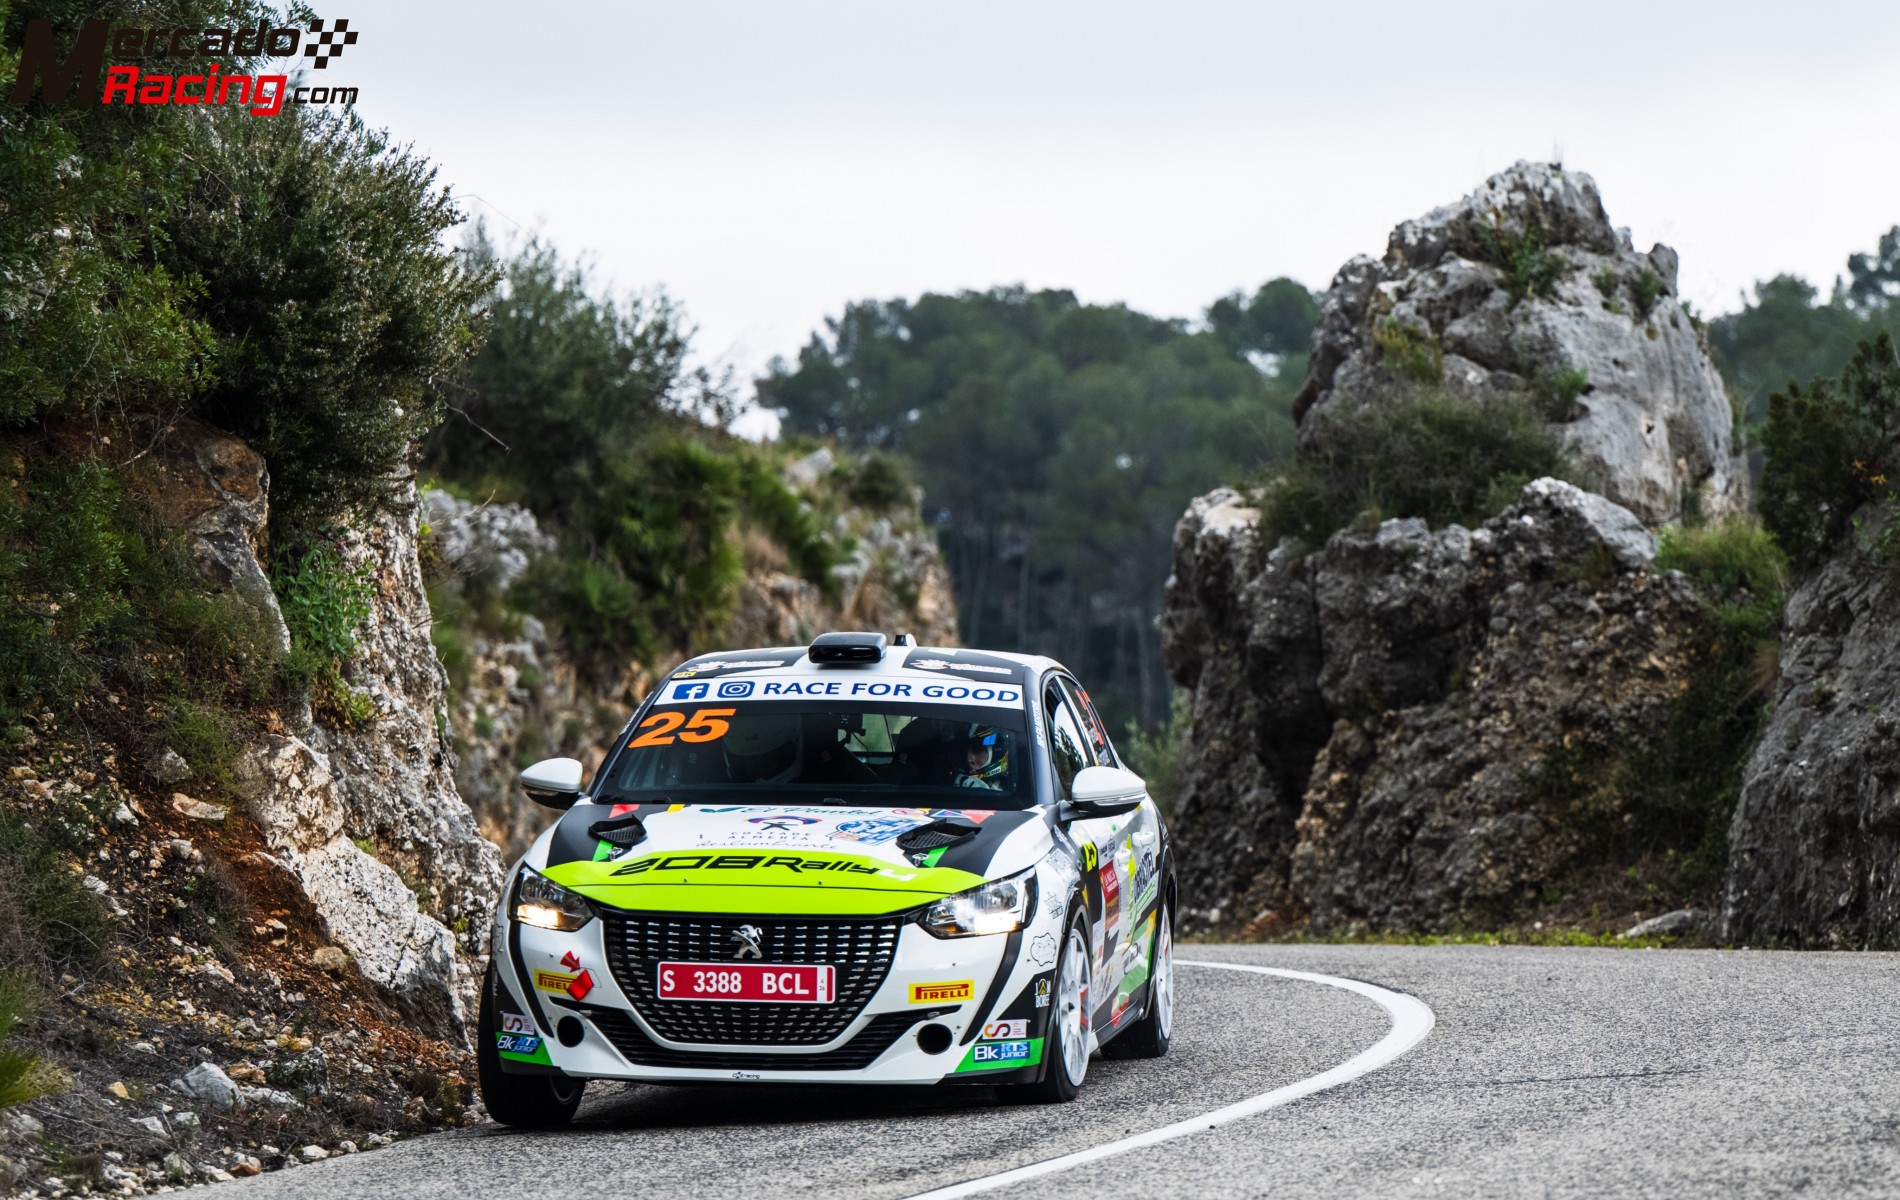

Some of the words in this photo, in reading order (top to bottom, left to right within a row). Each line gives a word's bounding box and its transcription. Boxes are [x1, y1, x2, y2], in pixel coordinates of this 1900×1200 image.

[763, 682, 843, 696] RACE
[851, 682, 912, 697] FOR
[922, 685, 1019, 702] GOOD
[628, 708, 737, 749] 25
[538, 973, 577, 991] PIREL
[662, 969, 676, 992] S
[693, 971, 742, 994] 3388
[762, 972, 810, 995] BCL
[915, 984, 969, 1000] PIRELLI
[974, 1045, 1000, 1061] Bk
[1001, 1042, 1028, 1052] RTS
[999, 1051, 1029, 1060] junior
